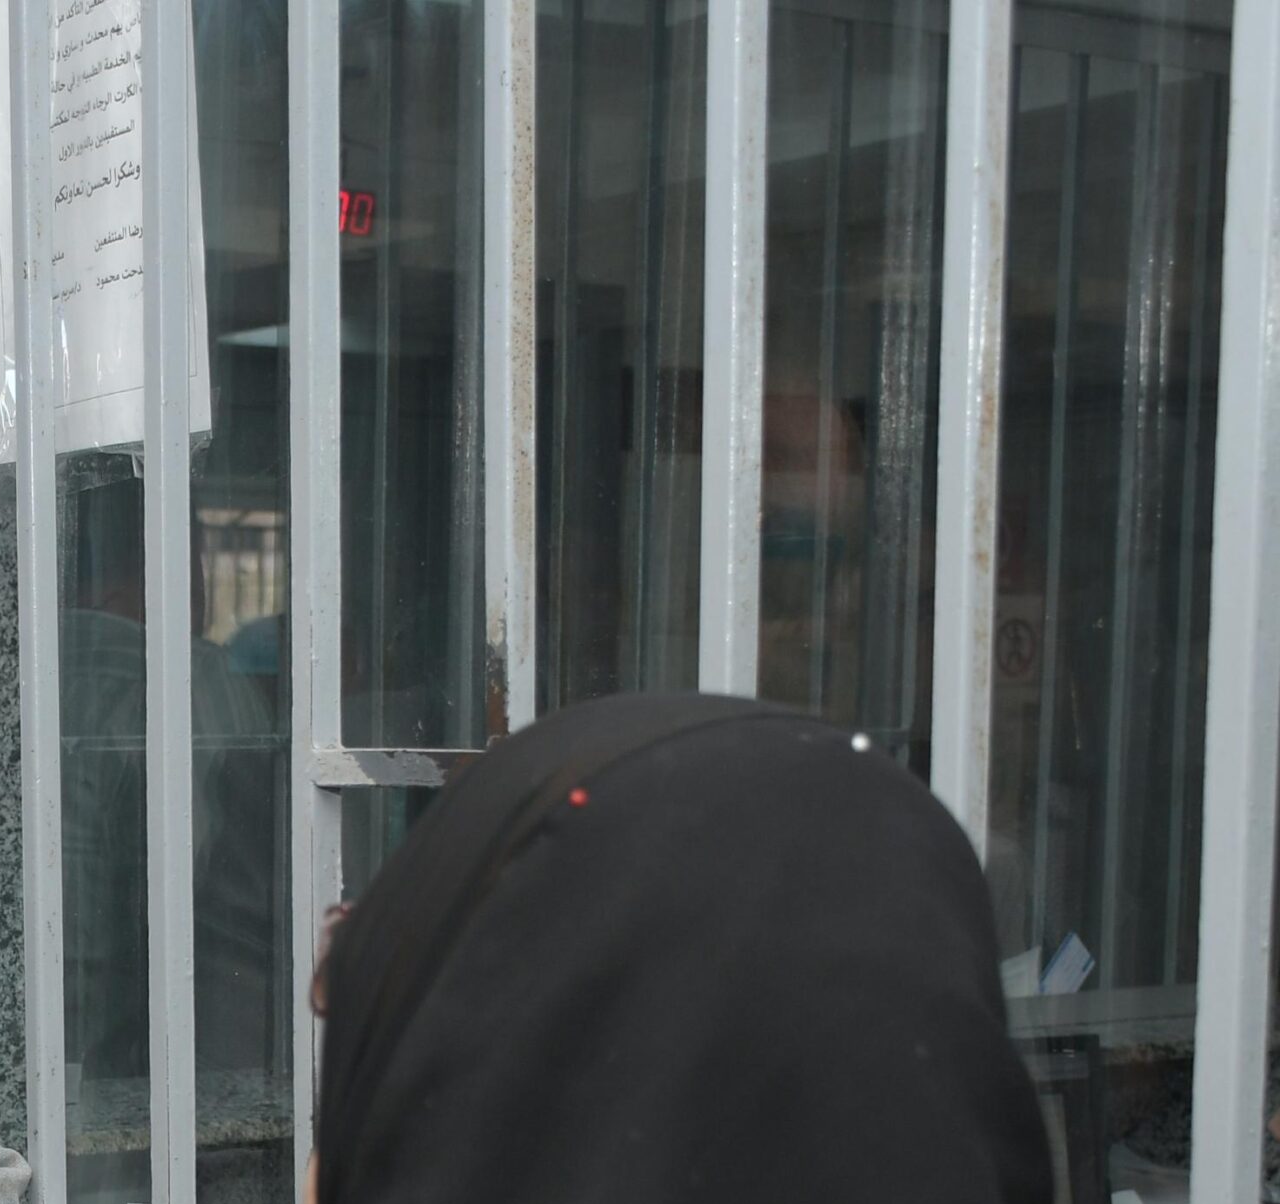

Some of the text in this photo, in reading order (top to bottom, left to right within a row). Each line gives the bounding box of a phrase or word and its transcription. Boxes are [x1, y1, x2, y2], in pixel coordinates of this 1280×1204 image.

[104, 51, 131, 70] الخدمة
[93, 91, 112, 111] الرجاء
[115, 84, 138, 104] الكارت
[95, 119, 135, 149] المستفيدين
[54, 161, 141, 212] وشكرا لحسن تعاونكم
[94, 226, 127, 253] المنتفعين
[128, 224, 143, 239] رضا
[95, 273, 120, 290] محمود
[122, 265, 144, 280] دحت
